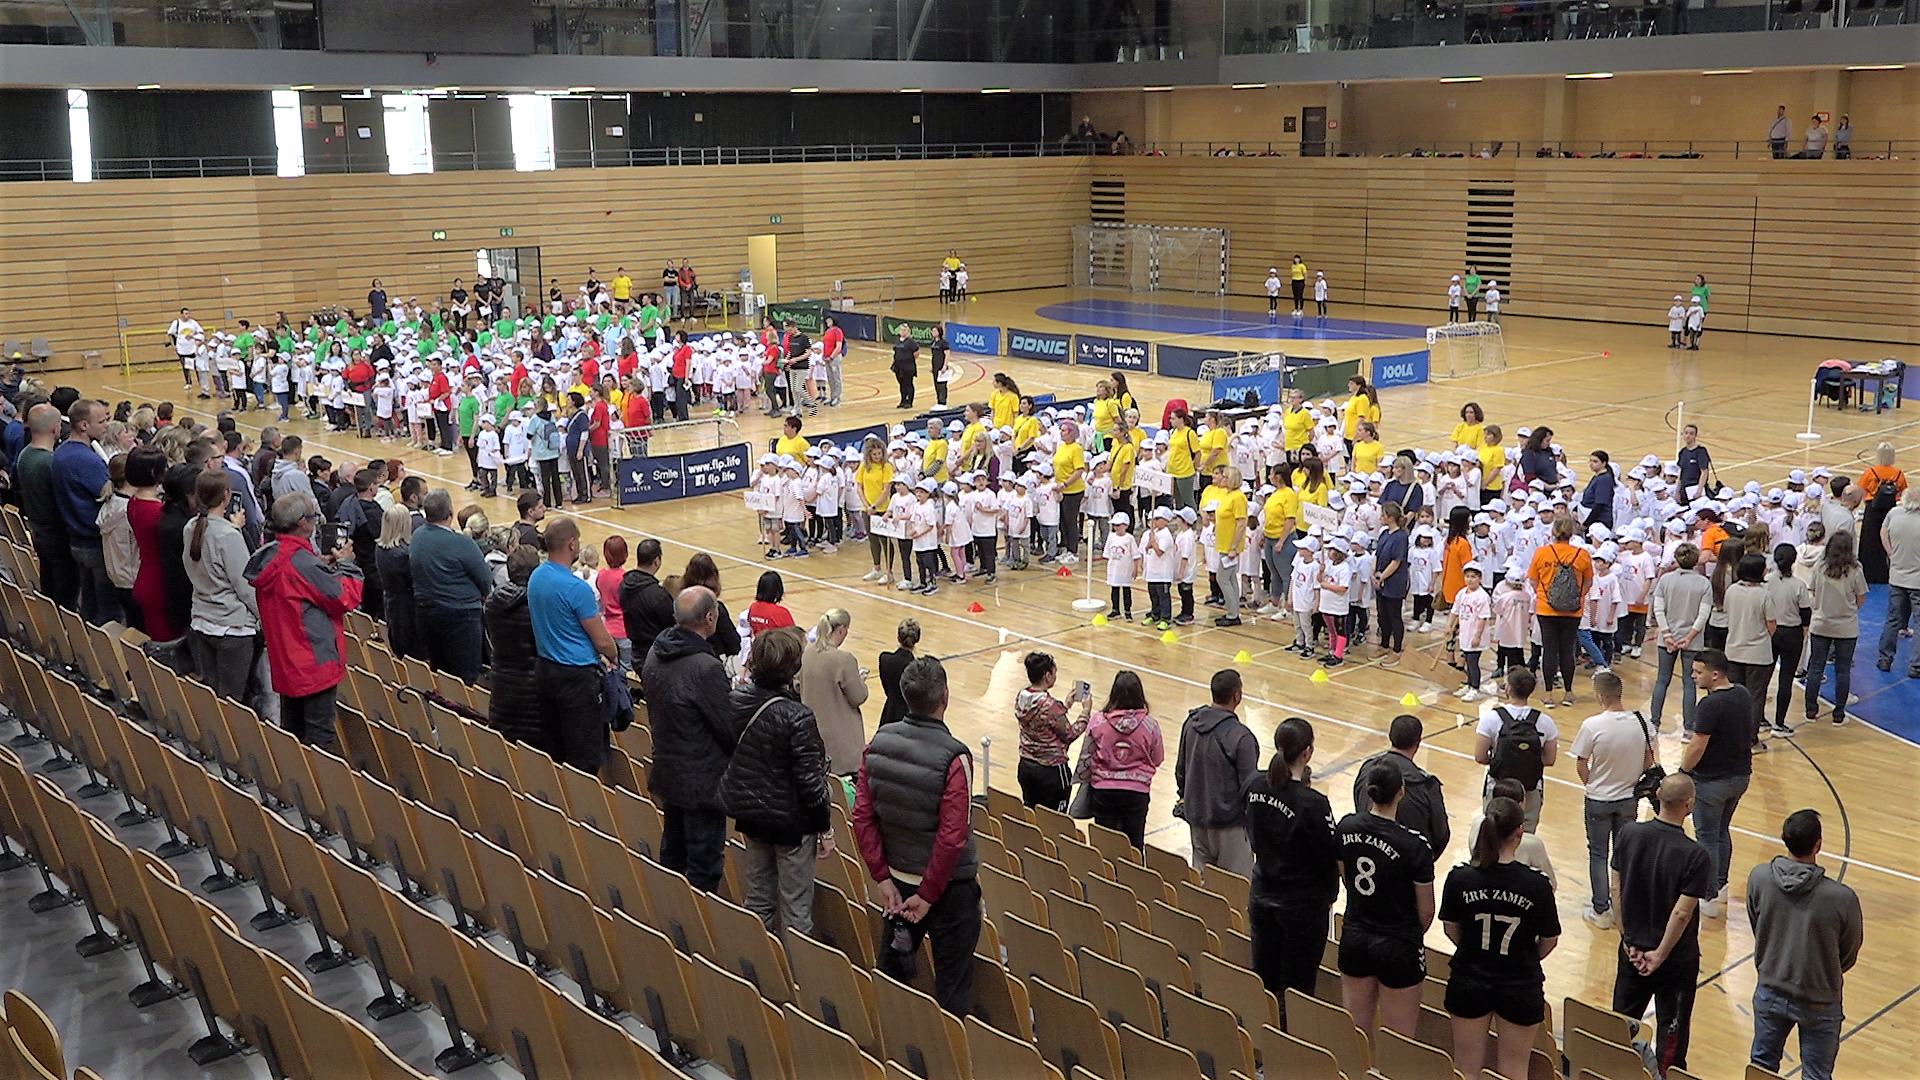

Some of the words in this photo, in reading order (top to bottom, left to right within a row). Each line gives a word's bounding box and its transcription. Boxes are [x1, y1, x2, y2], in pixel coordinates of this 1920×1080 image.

[955, 332, 985, 347] JOOLA
[1011, 335, 1067, 355] DONIC
[1428, 332, 1434, 343] 3
[1382, 363, 1414, 380] JOOLA
[652, 468, 679, 481] Smile
[687, 455, 741, 475] www.flp.life
[624, 484, 652, 494] FOREVER
[707, 473, 720, 487] flp
[721, 471, 737, 482] life
[1267, 795, 1296, 820] ZAMET
[1364, 834, 1401, 861] ZAMET
[1354, 856, 1377, 897] 8
[1492, 889, 1535, 911] ZAMET
[1474, 912, 1522, 956] 17
